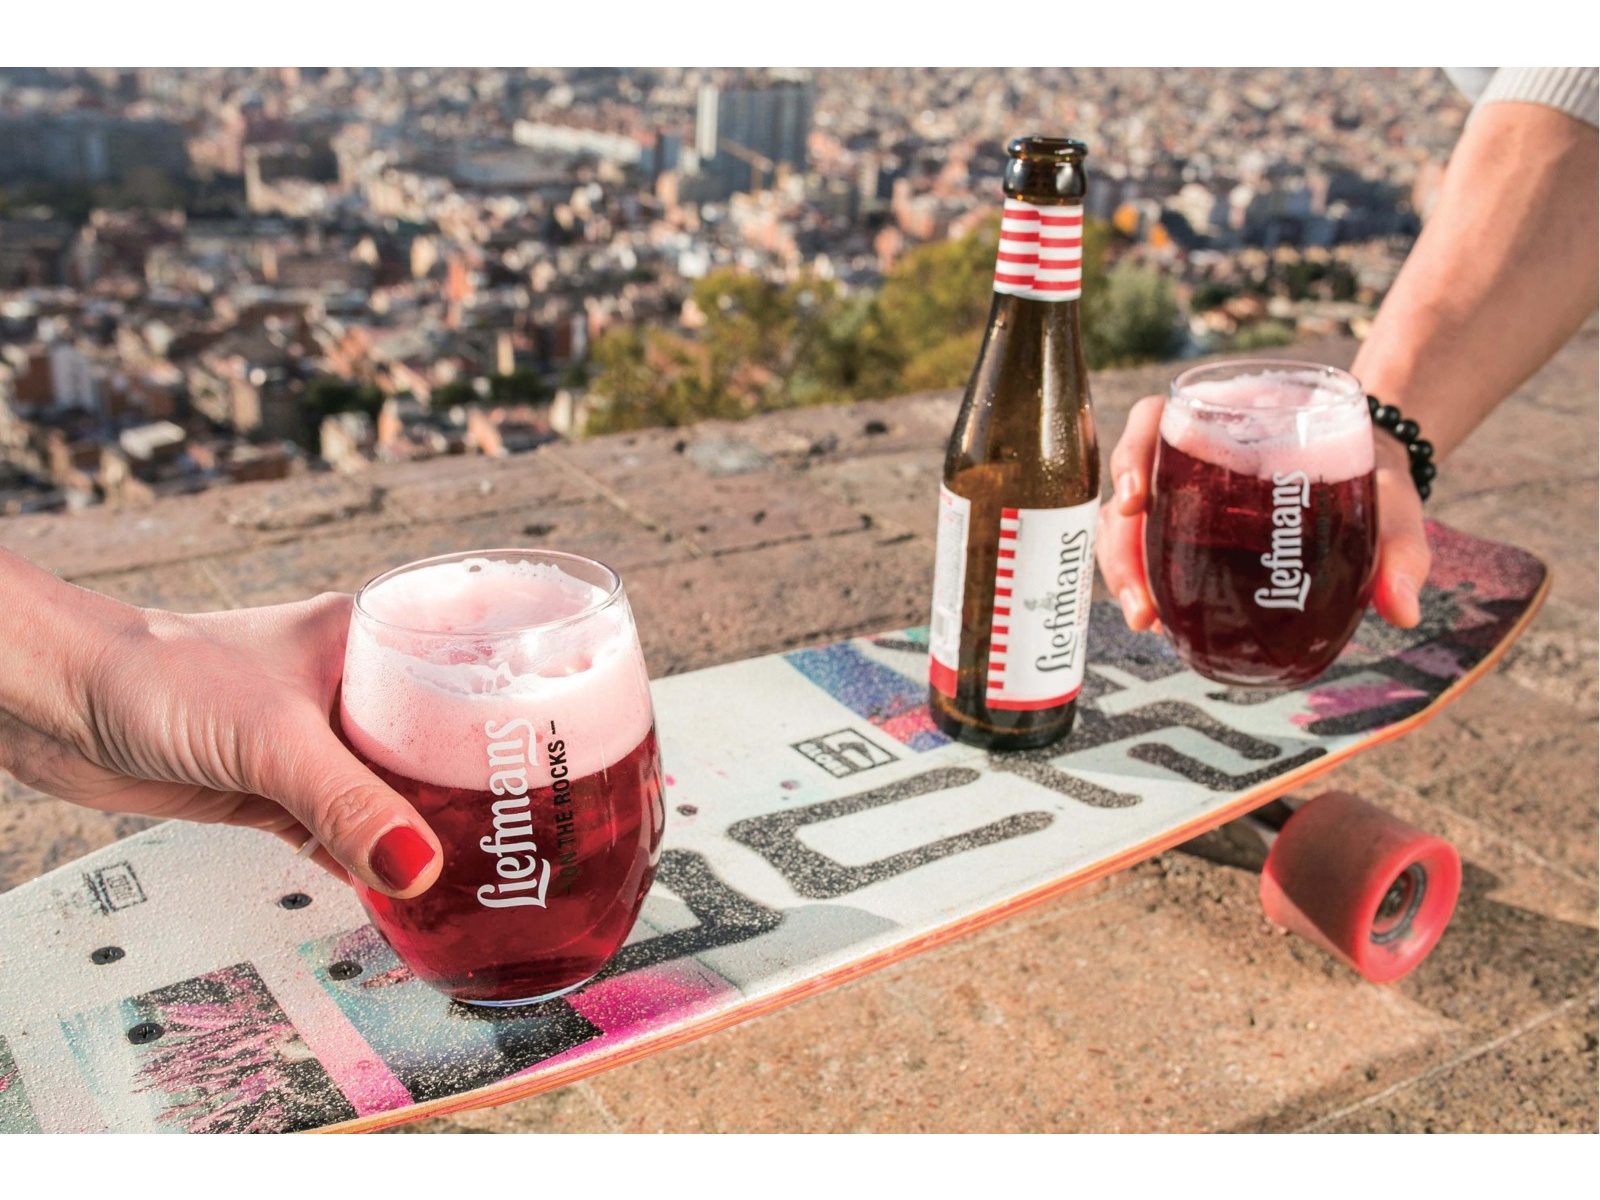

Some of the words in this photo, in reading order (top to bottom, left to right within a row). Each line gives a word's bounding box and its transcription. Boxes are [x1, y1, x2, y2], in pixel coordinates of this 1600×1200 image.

[1254, 470, 1311, 612] Liefmans
[1035, 529, 1088, 673] Liefmans
[477, 719, 551, 909] Liefmans
[547, 739, 571, 806] ROCKS
[556, 811, 574, 849] THE
[559, 851, 578, 879] ON
